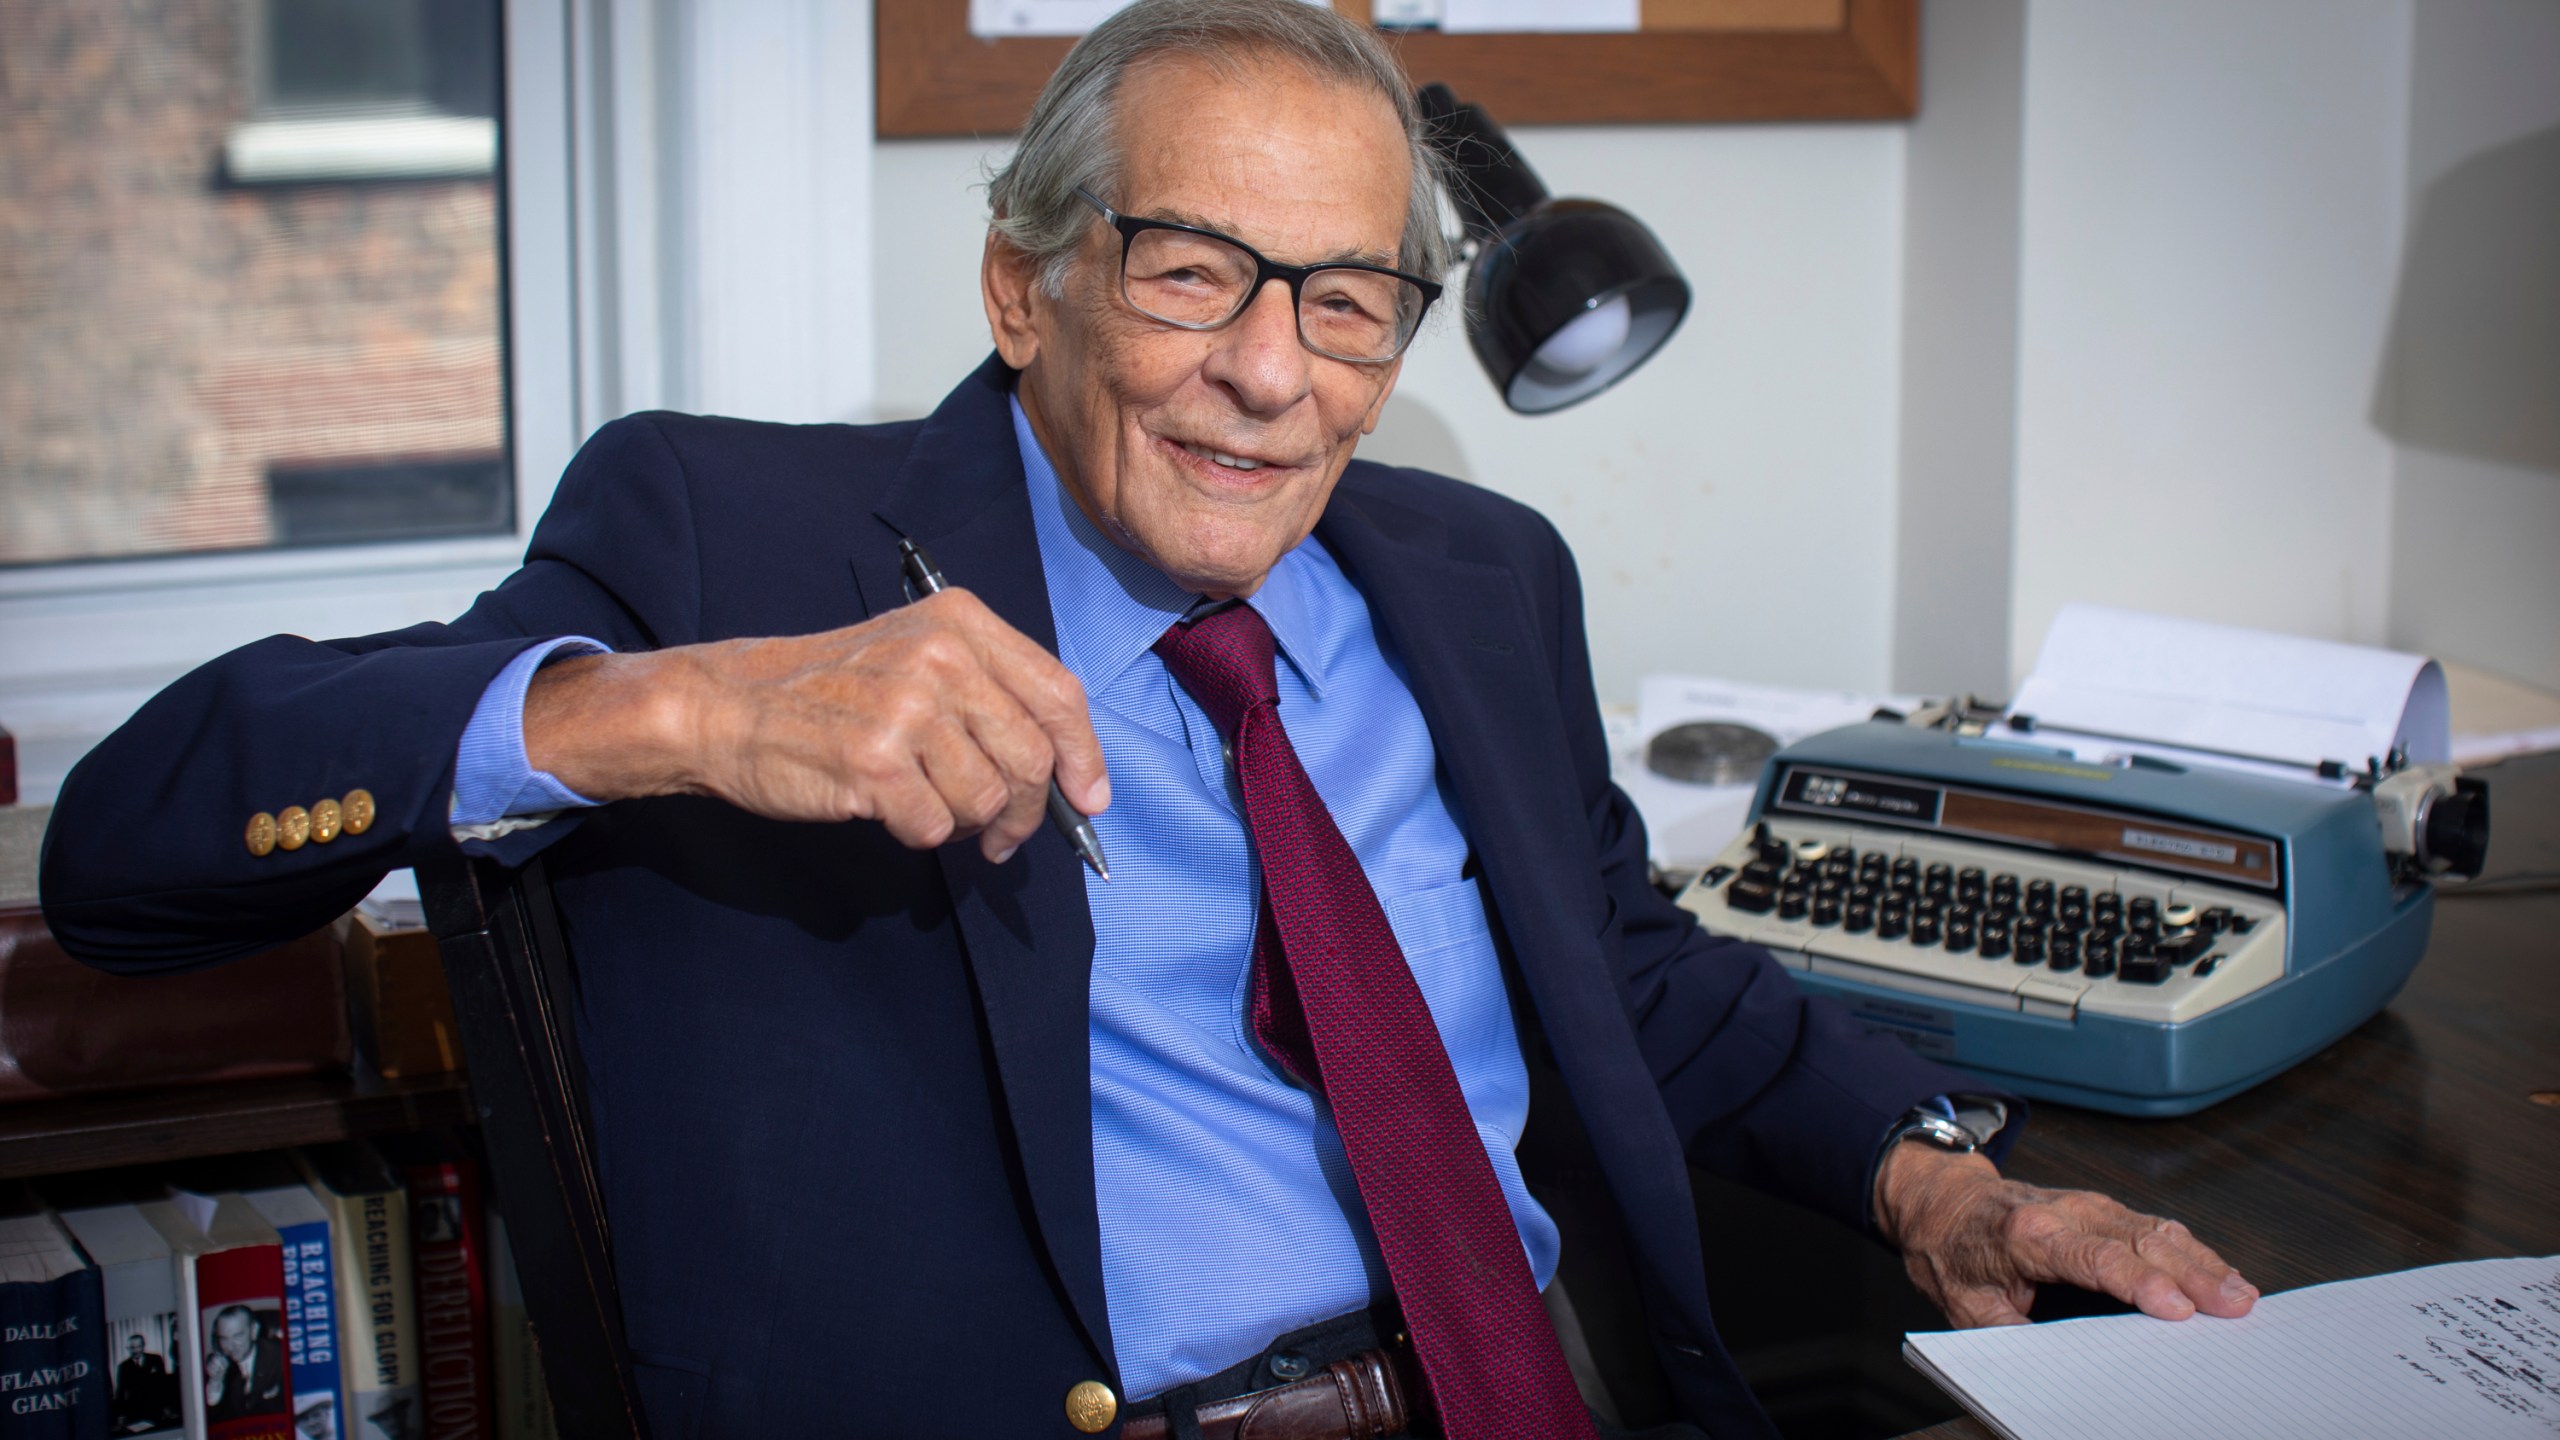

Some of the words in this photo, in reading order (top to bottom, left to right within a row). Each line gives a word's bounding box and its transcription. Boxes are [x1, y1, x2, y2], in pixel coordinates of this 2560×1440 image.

[365, 1196, 392, 1286] REACHING
[300, 1241, 333, 1364] REACHING
[372, 1291, 395, 1327] FOR
[5, 1317, 79, 1342] DALLEK
[0, 1361, 89, 1392] FLAWED
[375, 1332, 400, 1387] GLORY
[11, 1387, 80, 1415] GIANT
